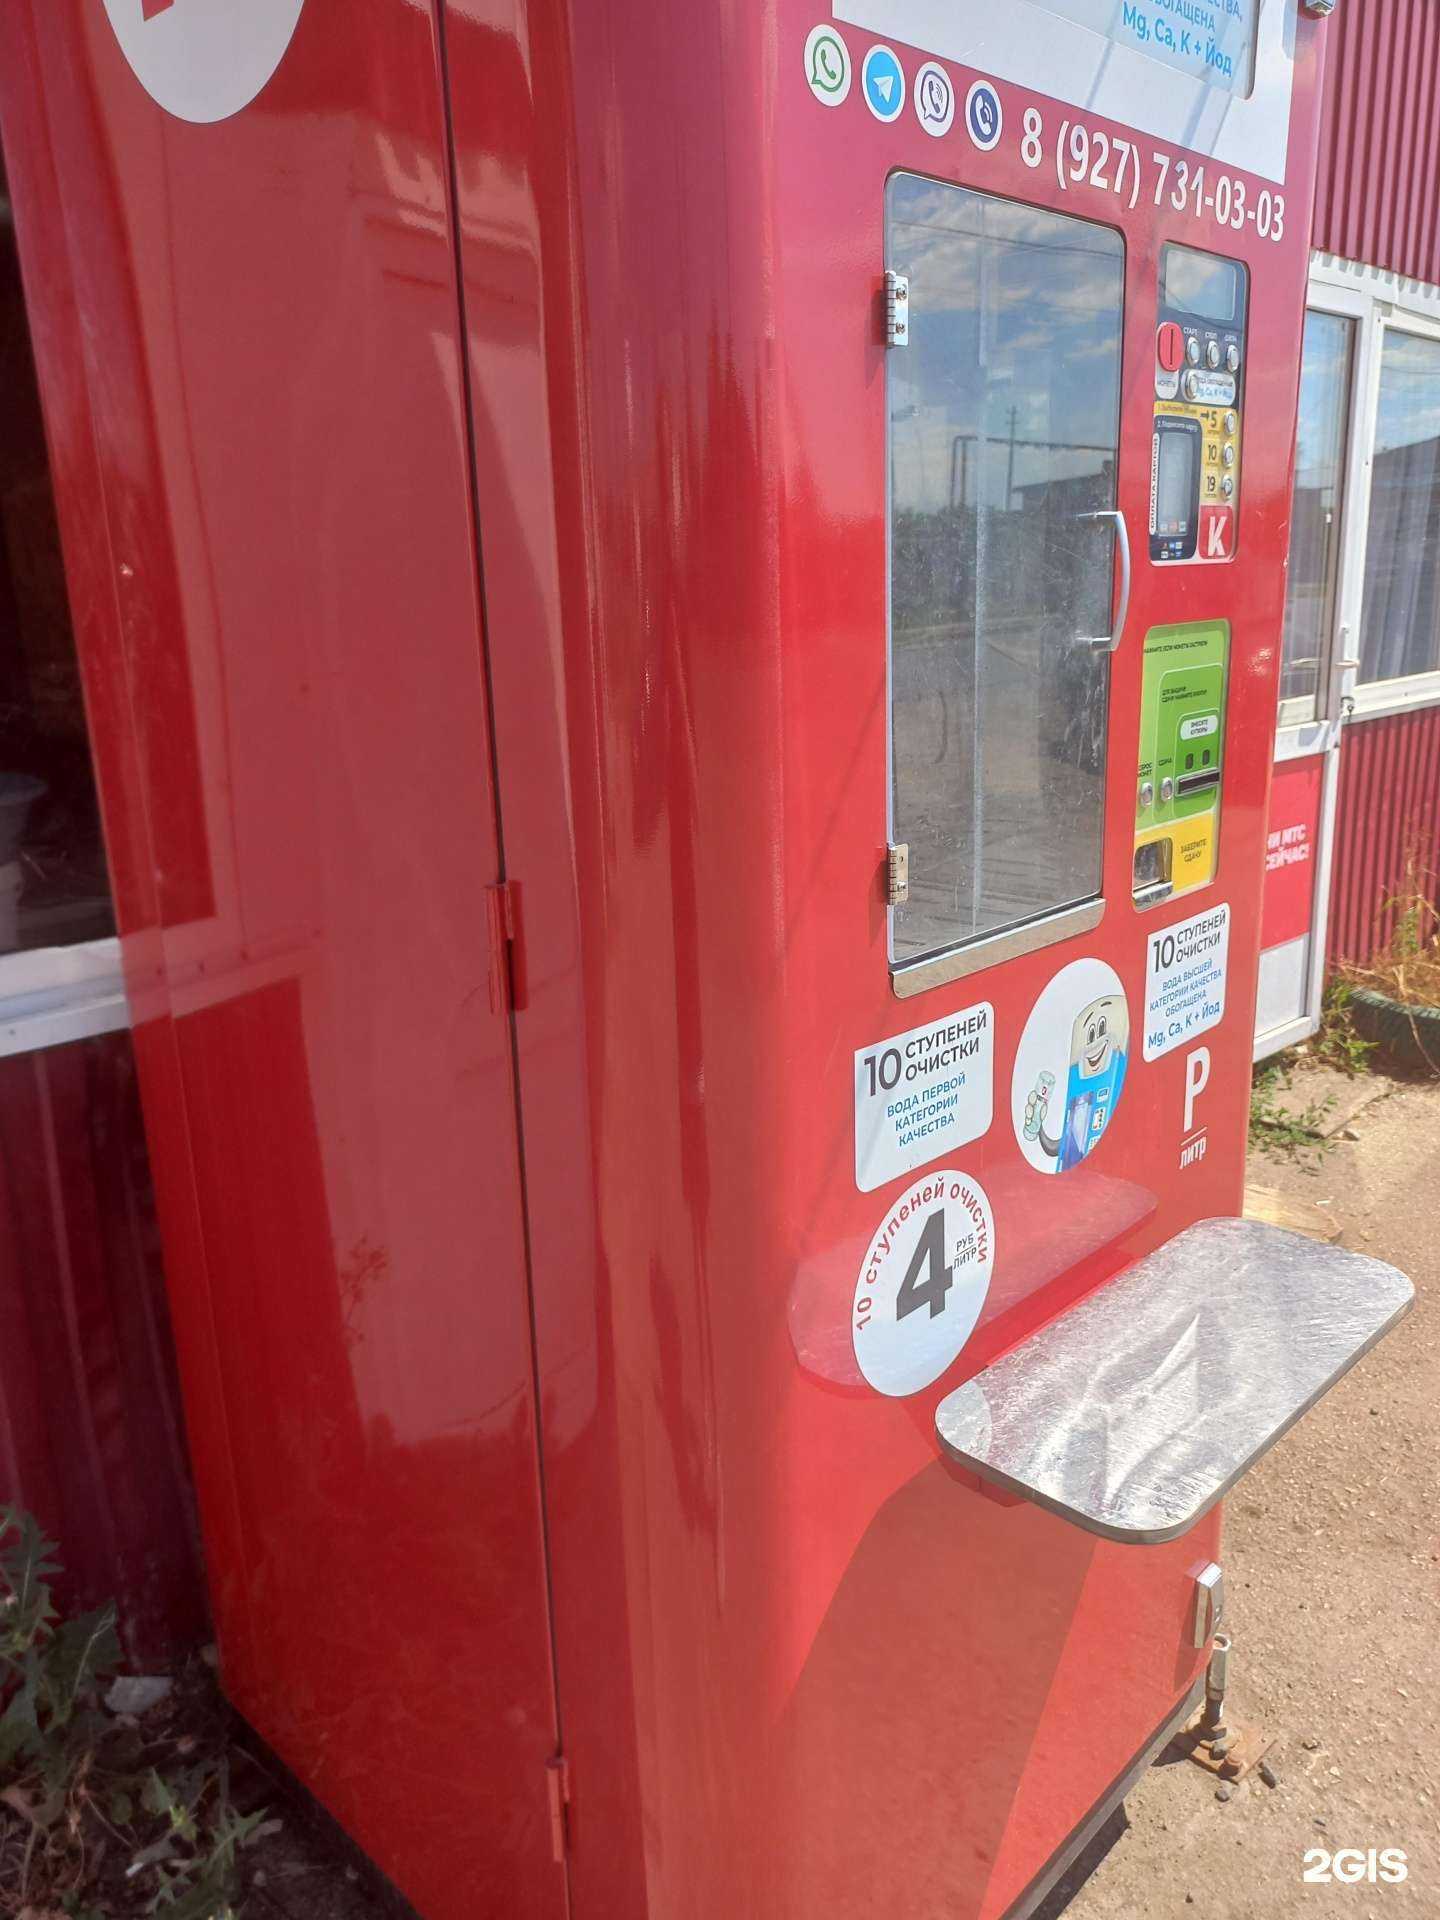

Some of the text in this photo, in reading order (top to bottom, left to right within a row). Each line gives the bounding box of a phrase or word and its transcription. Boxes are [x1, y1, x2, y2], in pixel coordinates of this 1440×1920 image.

[1122, 1, 1151, 41] Mg,
[1154, 18, 1176, 53] Ca,
[1205, 37, 1232, 78] Йод
[1021, 107, 1285, 242] 8 (927) 731-03-03
[1207, 444, 1217, 460] 10
[1153, 909, 1226, 973] 10 СТУПЕНЕЙ
[1175, 931, 1221, 963] ОЧИСТКИ
[1149, 969, 1222, 1012] КАТЕГОРИИ КАЧЕСТВА
[1162, 958, 1213, 992] ВОДА ВЫСШЕЙ
[1165, 989, 1207, 1017] ОБОГАЩЕНА
[1148, 1030, 1166, 1049] Mg,
[1168, 1022, 1183, 1038] Ca,
[1202, 1000, 1220, 1020] Йод
[864, 1009, 987, 1097] 10 СТУПЕНЕЙ
[905, 1036, 980, 1081] ОЧИСТКИ
[887, 1071, 966, 1118] ВОДА ПЕРВОЙ
[895, 1093, 958, 1132] КАТЕГОРИИ
[899, 1112, 955, 1147] КАЧЕСТВА
[1180, 1136, 1207, 1170] ЛИТР
[953, 1247, 977, 1270] ЛИТР
[955, 1232, 974, 1252] РУБ
[896, 1207, 953, 1322] 4
[856, 1296, 872, 1331] 10
